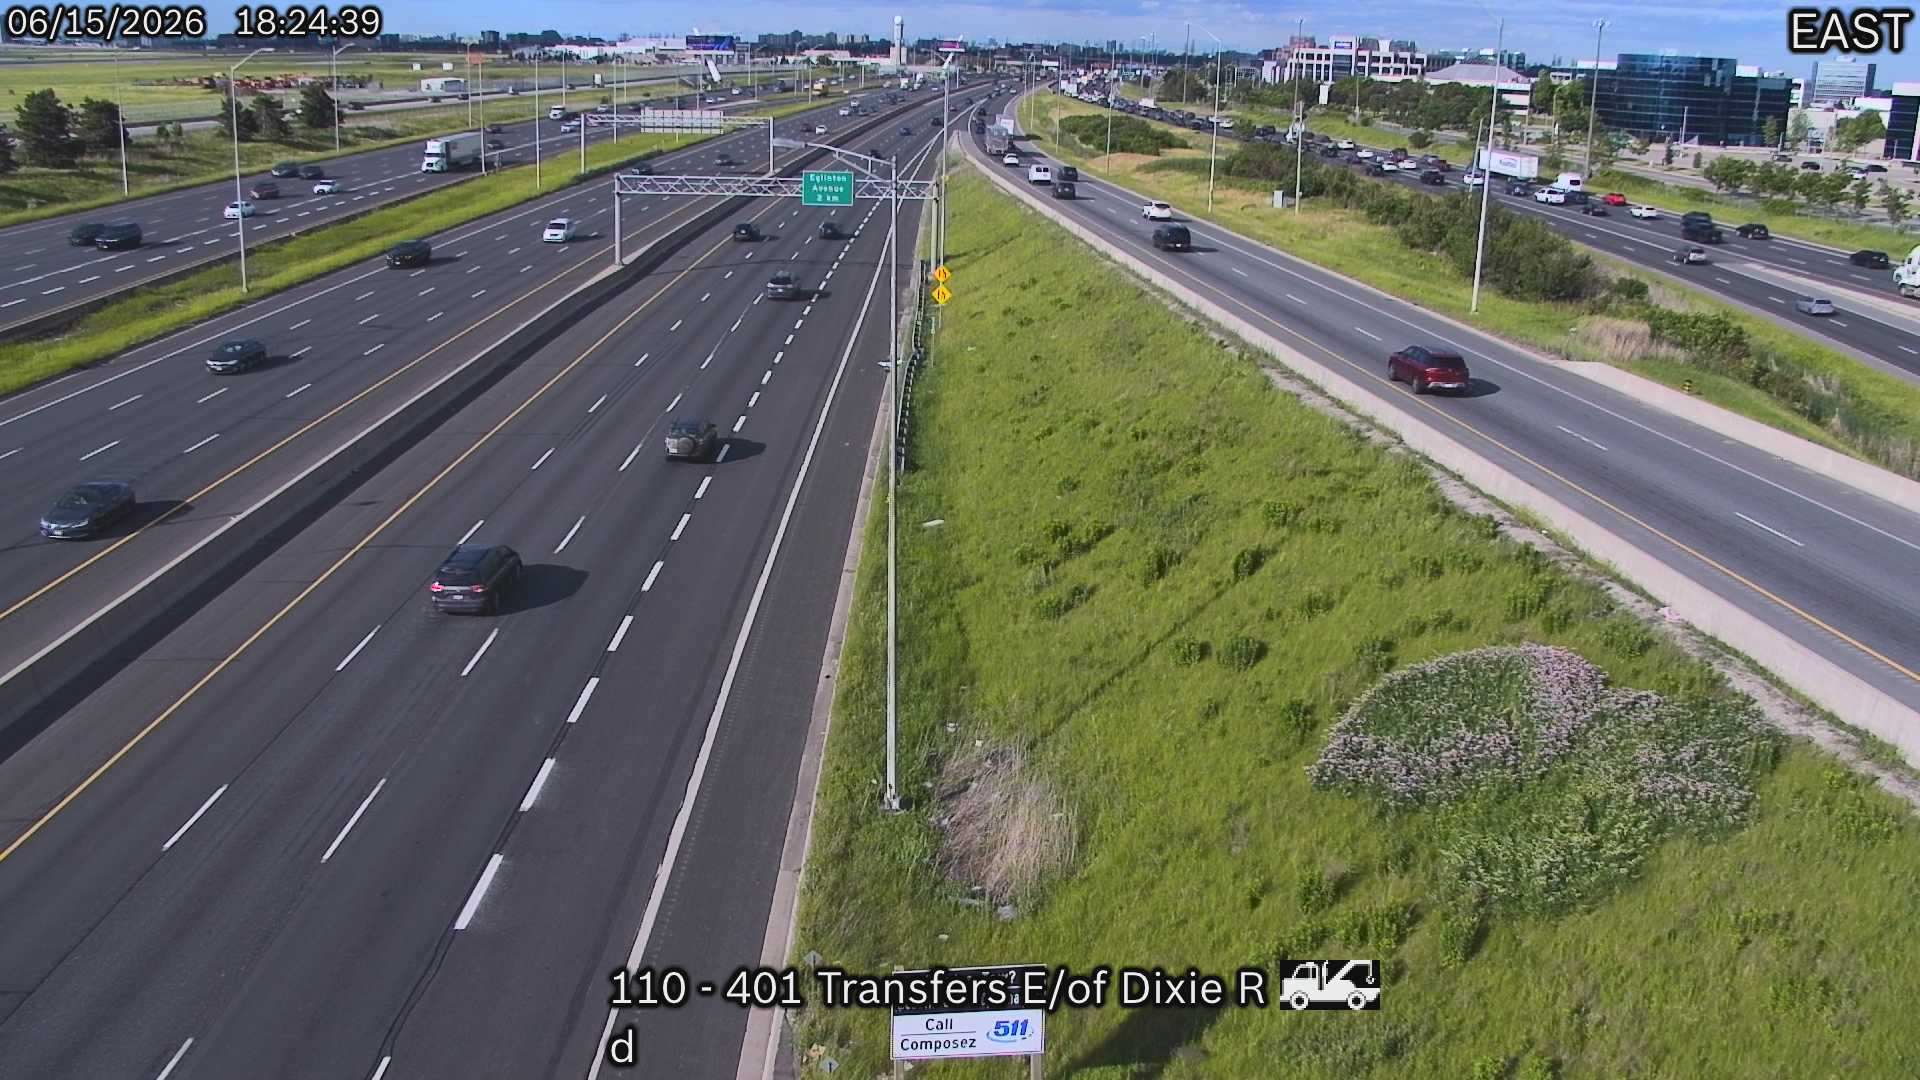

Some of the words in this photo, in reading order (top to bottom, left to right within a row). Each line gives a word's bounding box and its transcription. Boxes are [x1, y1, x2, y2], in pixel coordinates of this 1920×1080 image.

[925, 1018, 953, 1031] Call
[993, 1018, 1029, 1037] 511
[900, 1038, 977, 1053] Composez
